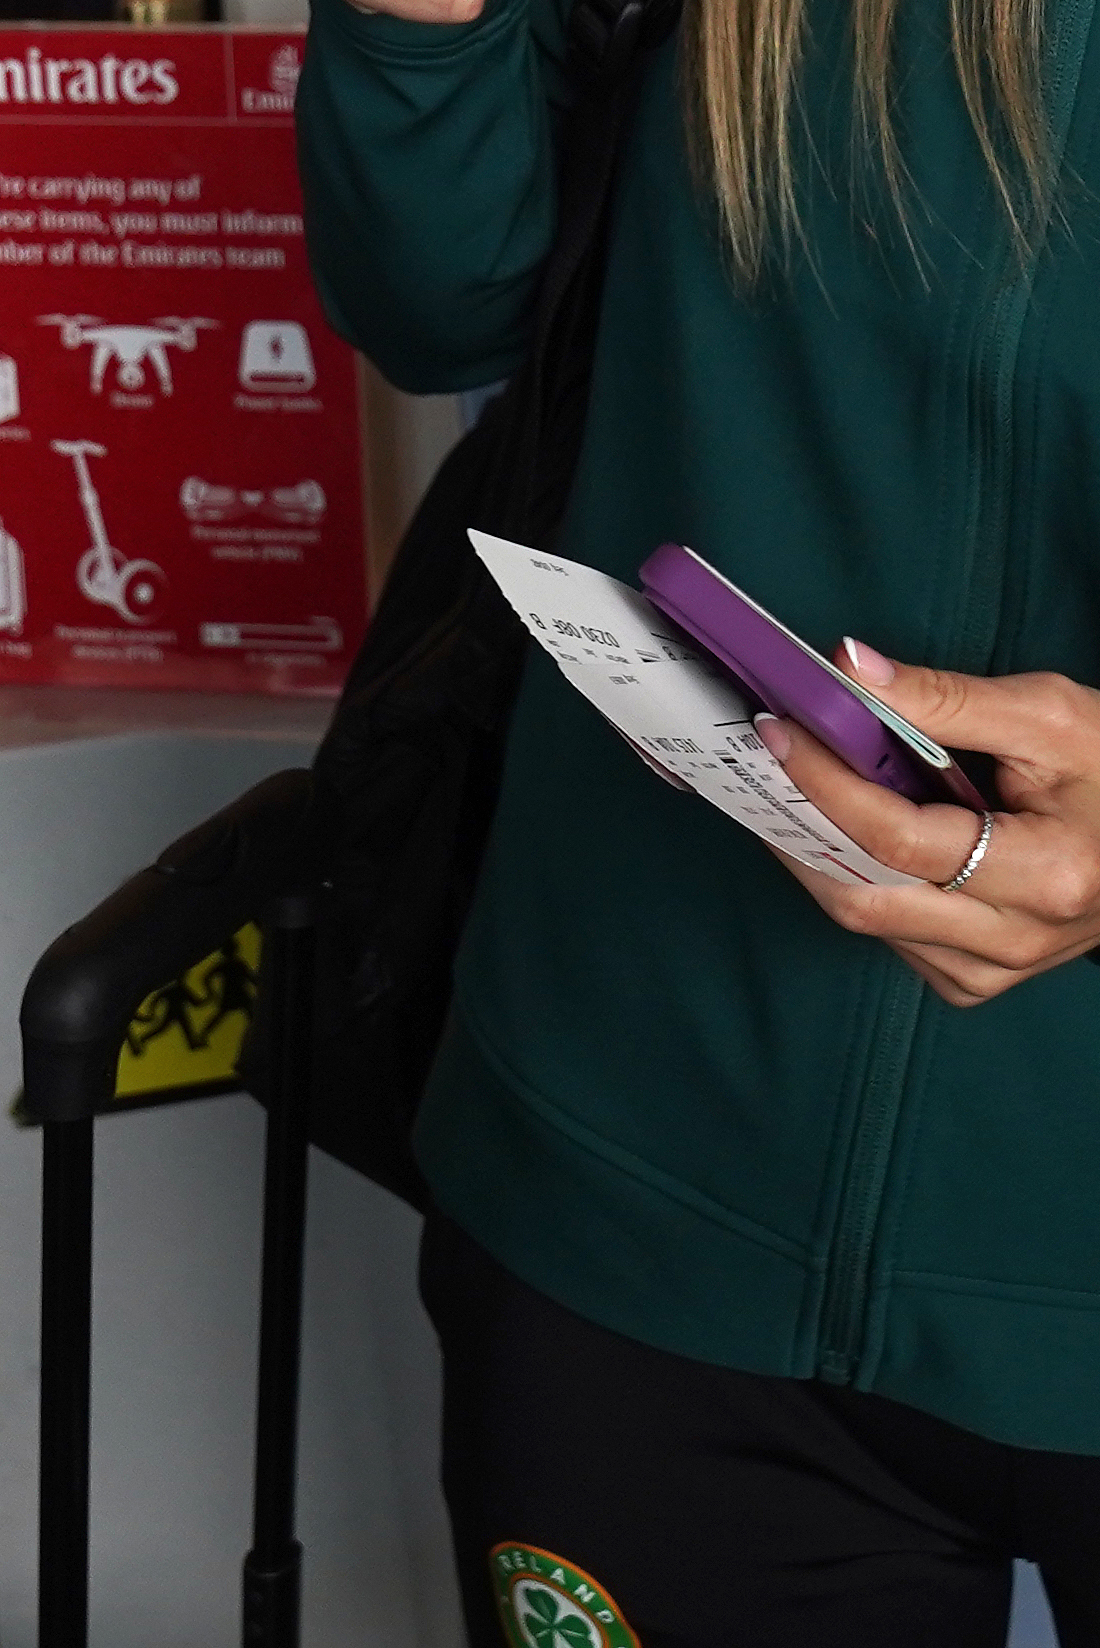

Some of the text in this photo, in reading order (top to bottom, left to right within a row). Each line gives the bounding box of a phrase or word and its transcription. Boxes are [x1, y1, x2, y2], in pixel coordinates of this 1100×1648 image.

[0, 47, 180, 104] mirates
[27, 173, 126, 206] carrying
[128, 178, 172, 206] any
[173, 173, 201, 201] of
[110, 212, 158, 239] you
[160, 212, 218, 235] must
[48, 239, 75, 266] of
[78, 239, 118, 267] the
[120, 240, 224, 269] Emirates
[225, 247, 285, 270] team
[498, 1551, 616, 1624] RELAND
